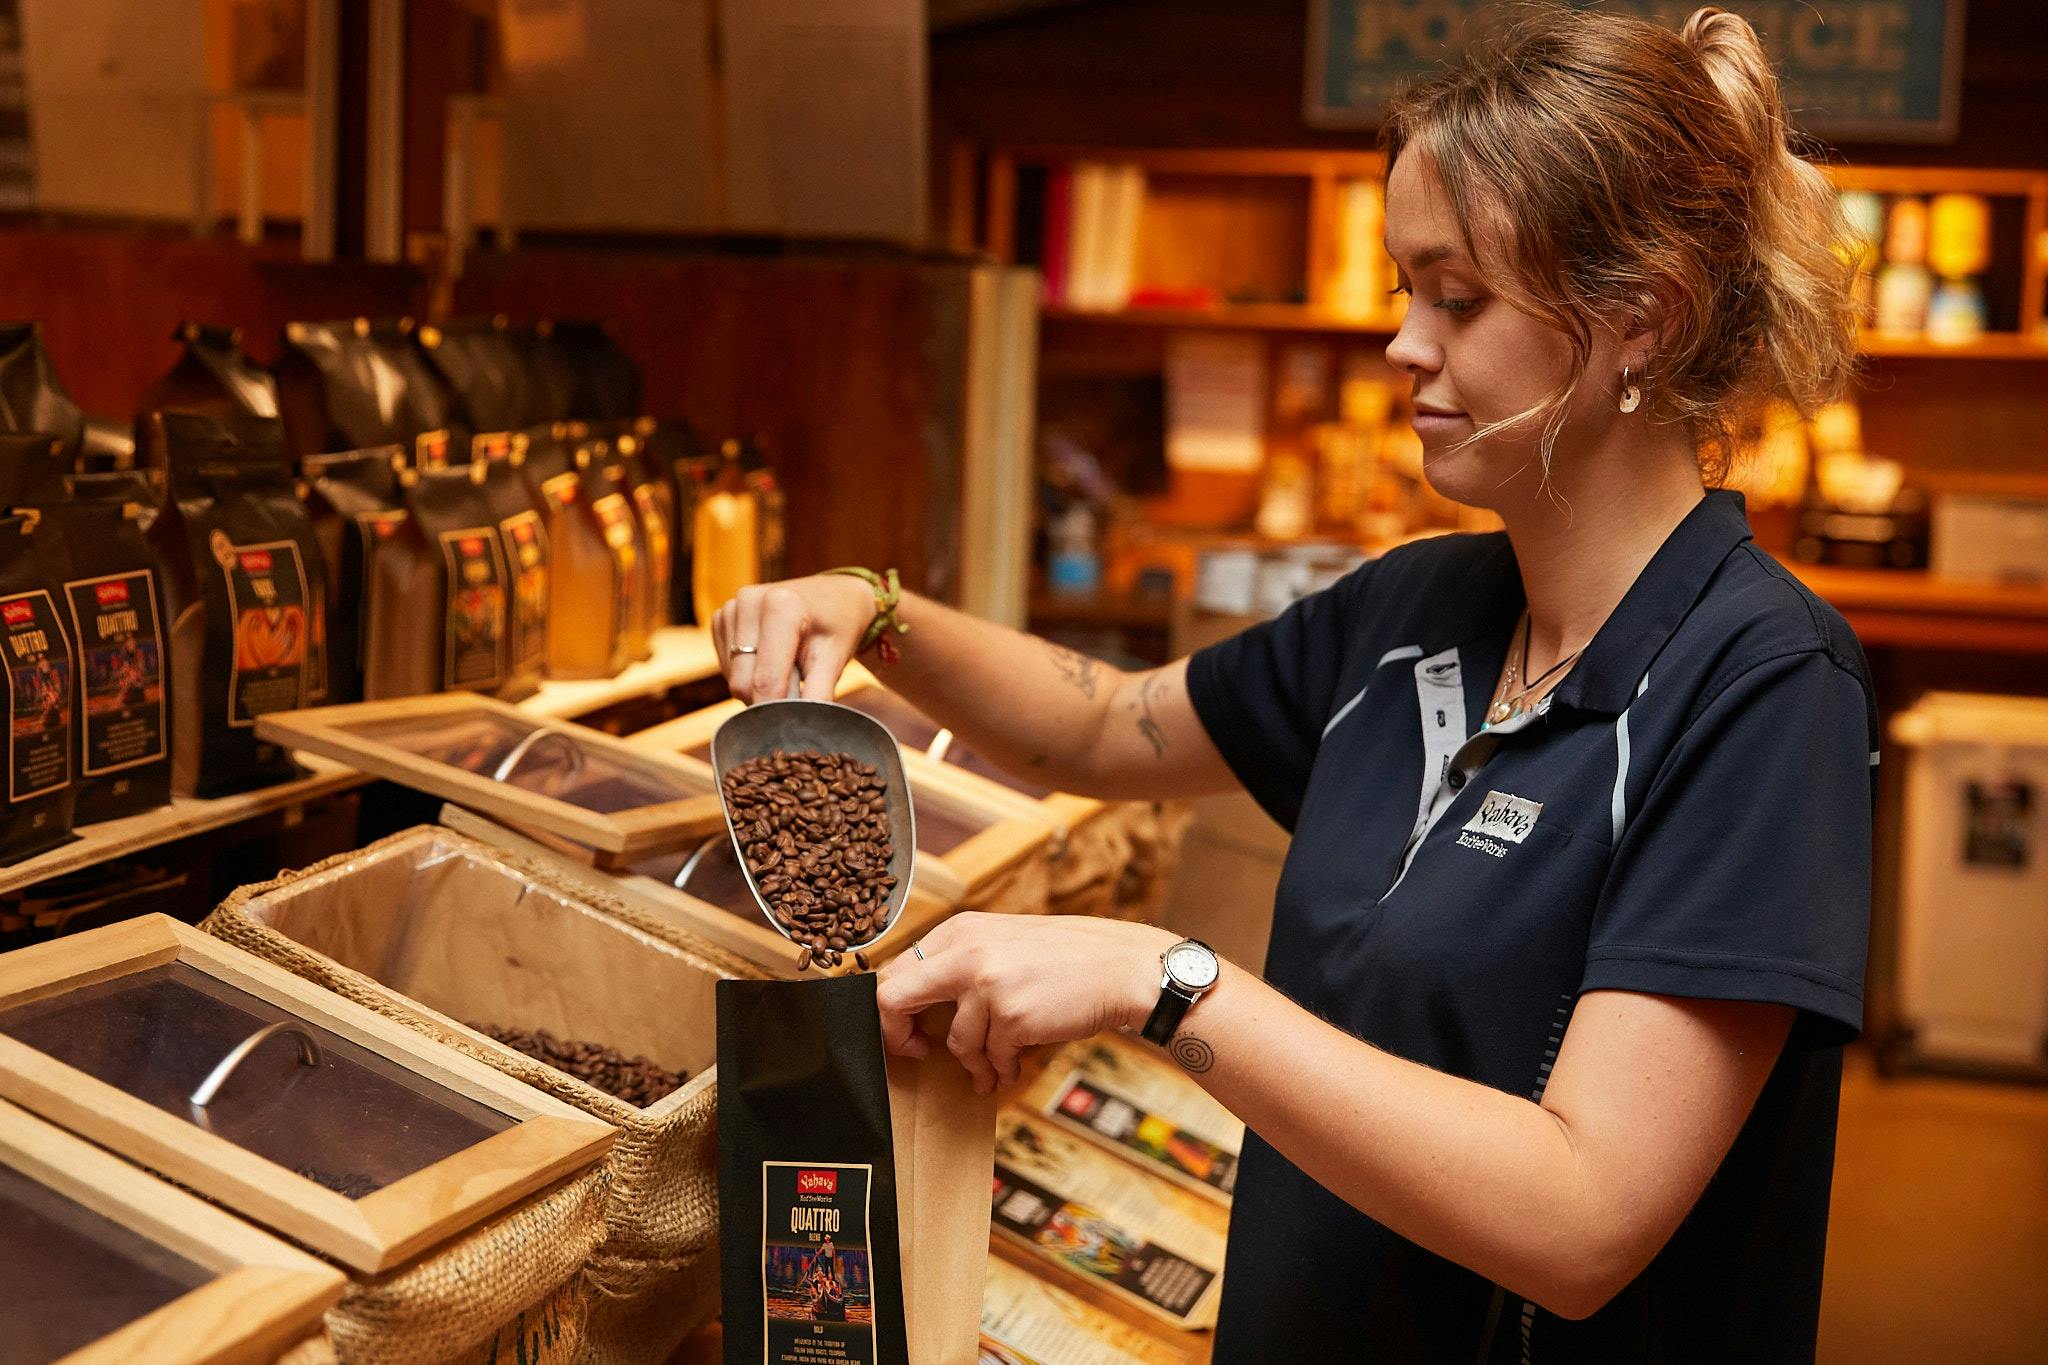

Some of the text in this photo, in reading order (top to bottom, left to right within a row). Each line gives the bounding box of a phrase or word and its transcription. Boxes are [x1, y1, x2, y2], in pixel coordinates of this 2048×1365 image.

[1480, 799, 1529, 836] Yahava
[800, 1173, 834, 1191] Yahava
[791, 1206, 840, 1234] QUATTRO
